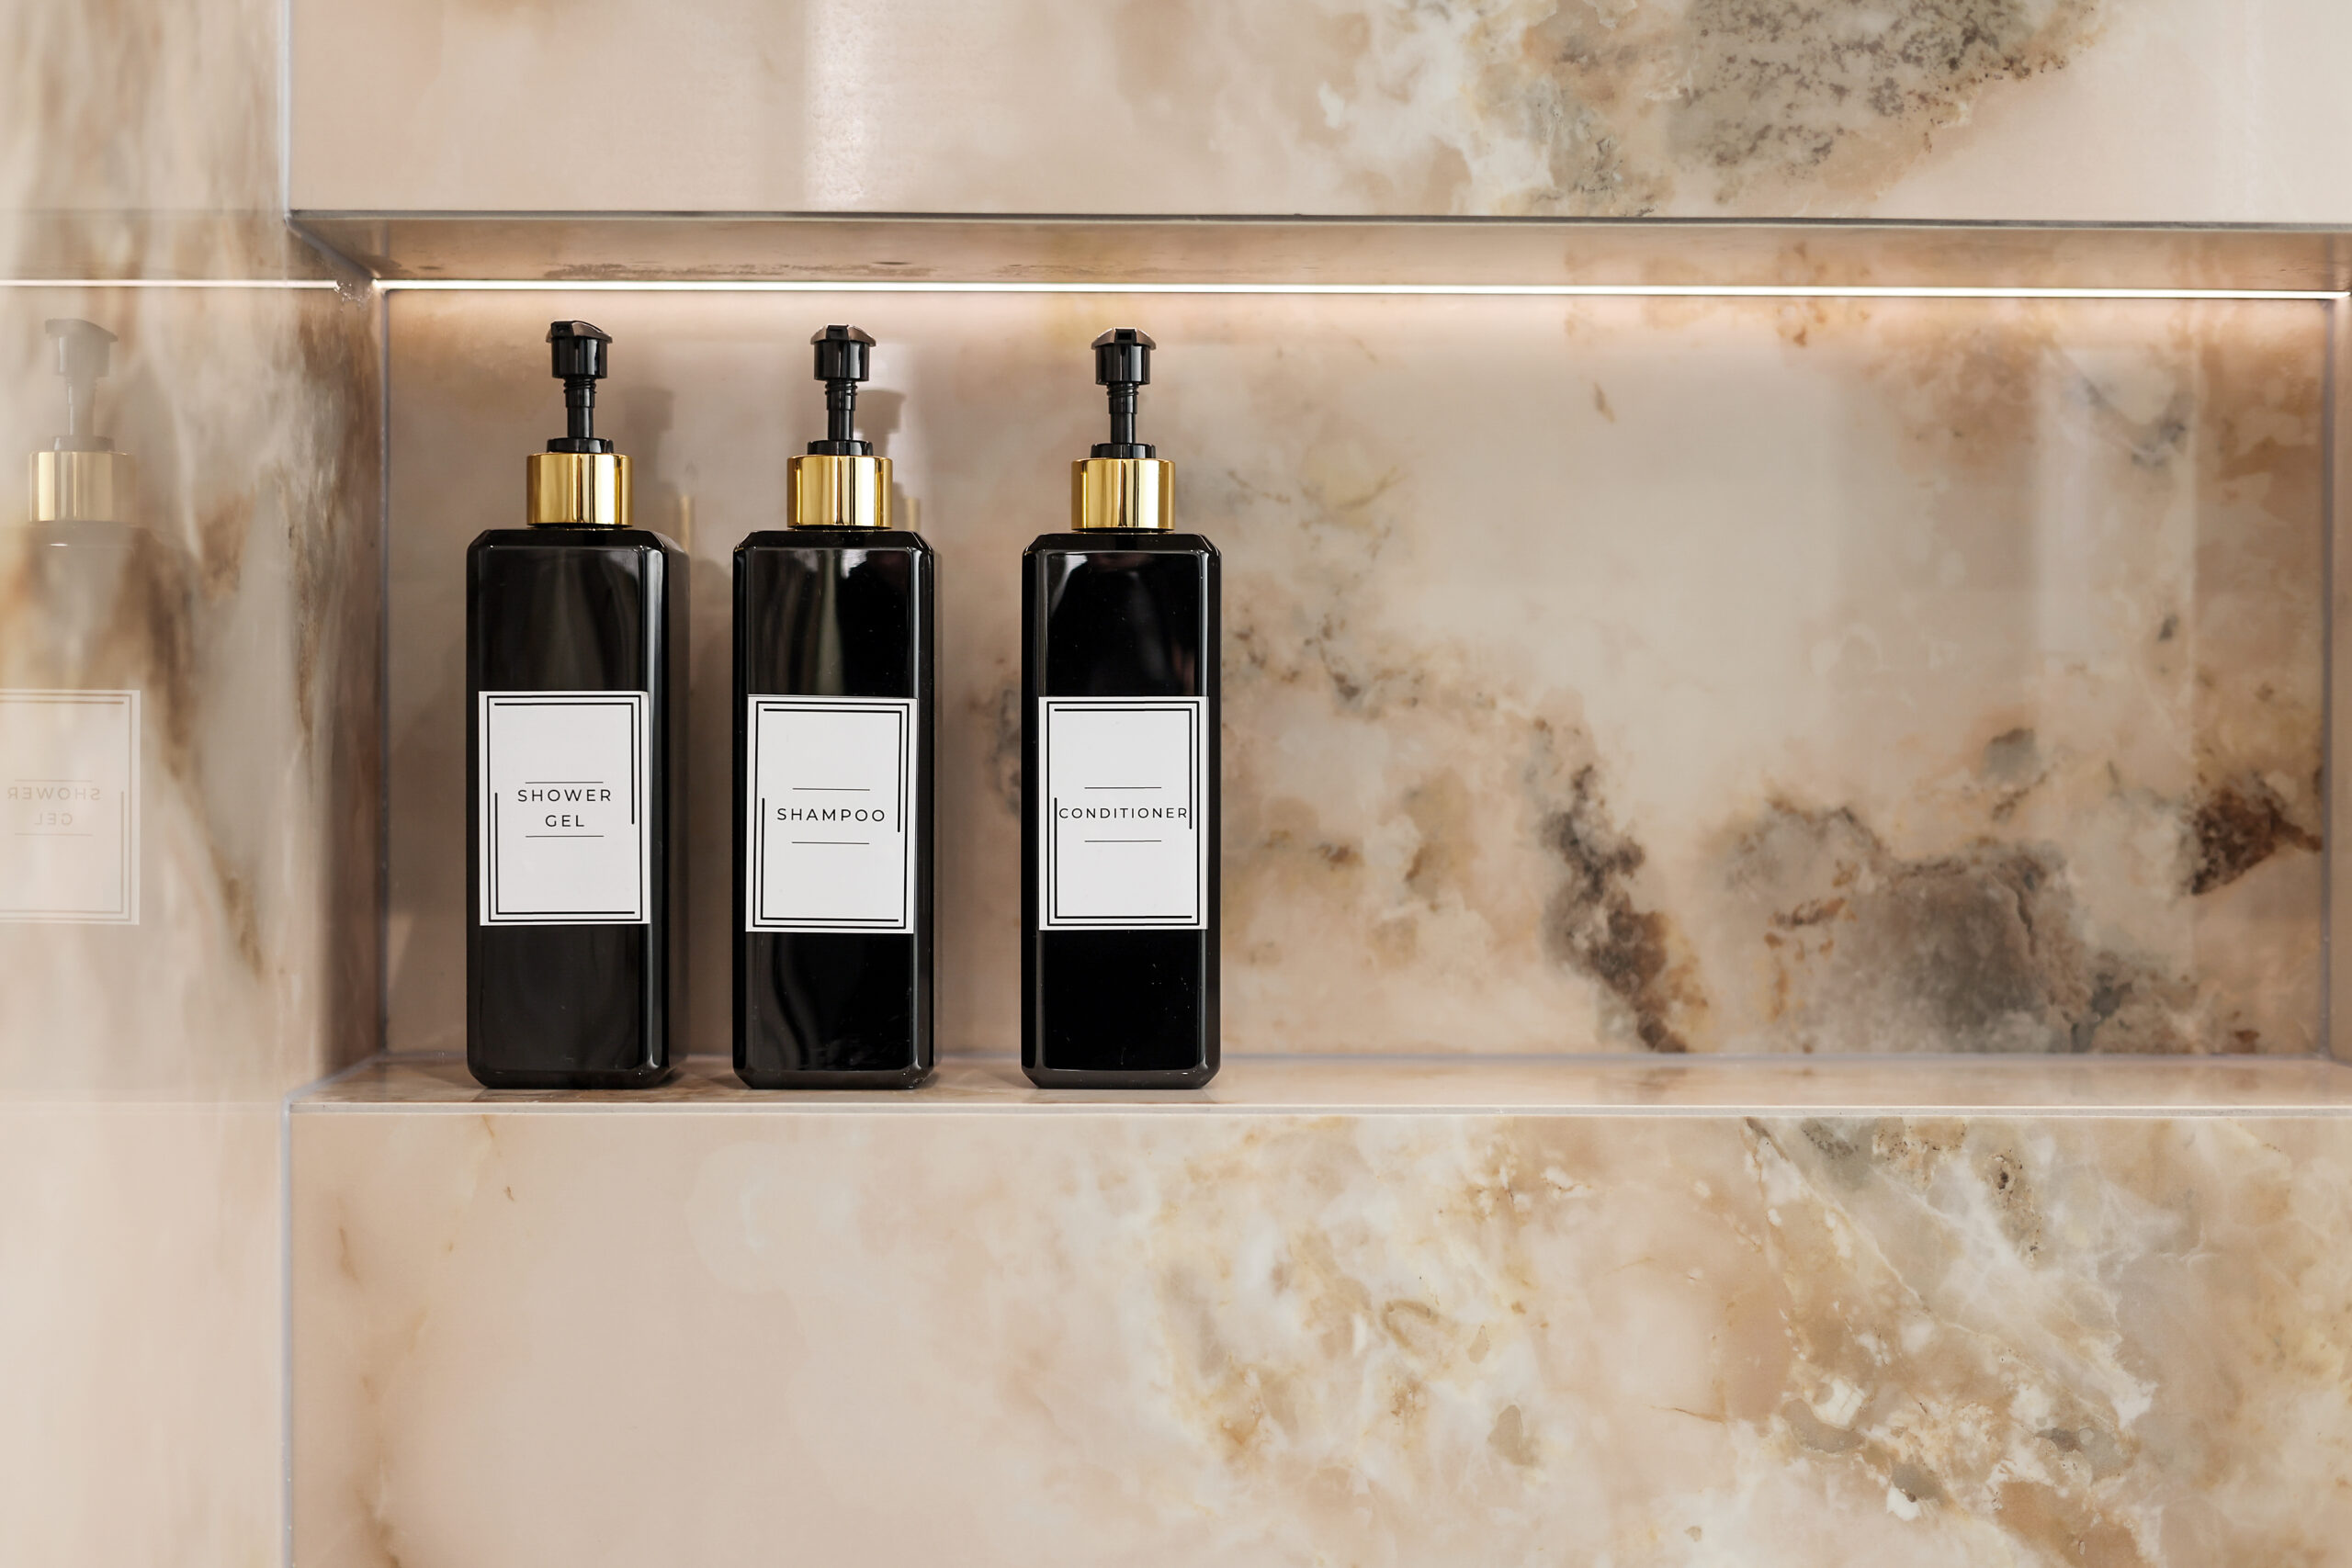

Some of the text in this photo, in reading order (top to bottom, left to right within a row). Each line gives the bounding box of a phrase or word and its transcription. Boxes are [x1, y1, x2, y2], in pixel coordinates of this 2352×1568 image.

[517, 789, 611, 803] SHOWER
[777, 807, 885, 822] SHAMPOO
[1058, 807, 1187, 819] CONDITIONER
[545, 814, 584, 828] GEL
